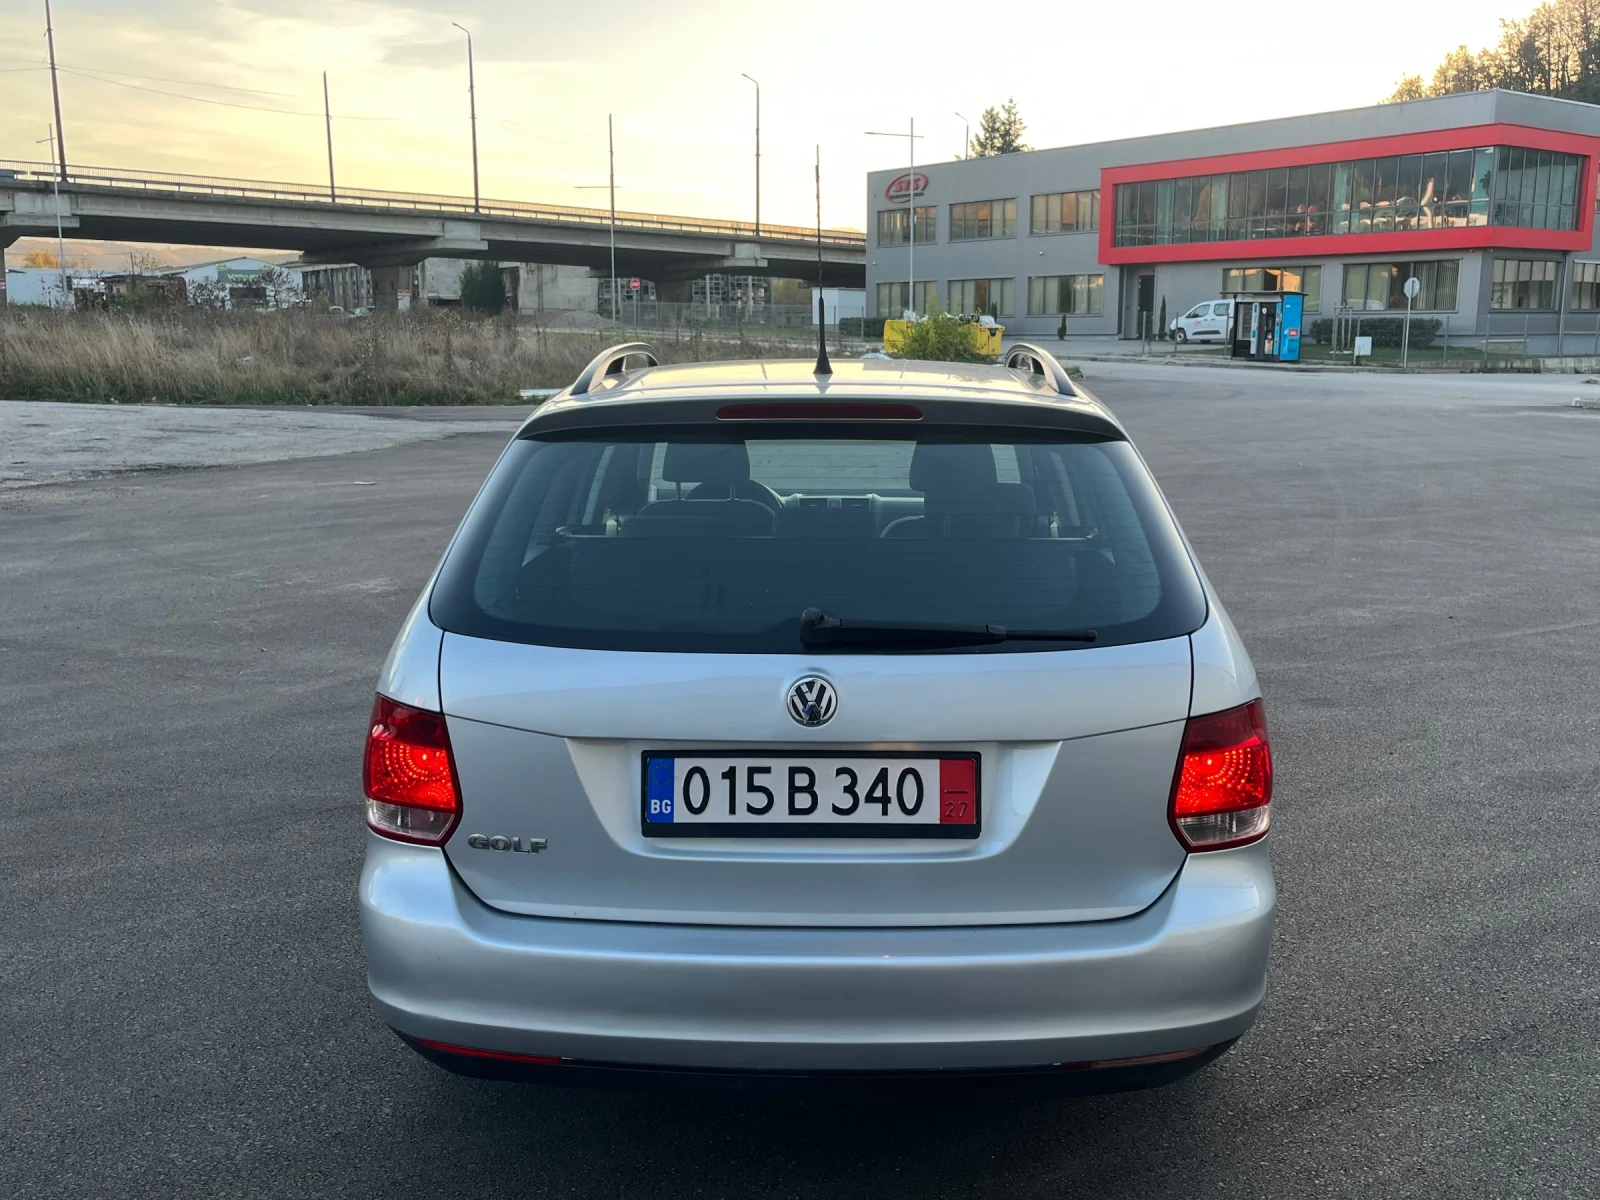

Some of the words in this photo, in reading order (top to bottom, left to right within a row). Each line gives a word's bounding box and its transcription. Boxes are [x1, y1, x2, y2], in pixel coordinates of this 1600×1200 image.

[650, 799, 672, 815] BG
[945, 801, 968, 817] 27
[467, 833, 548, 855] GOLF
